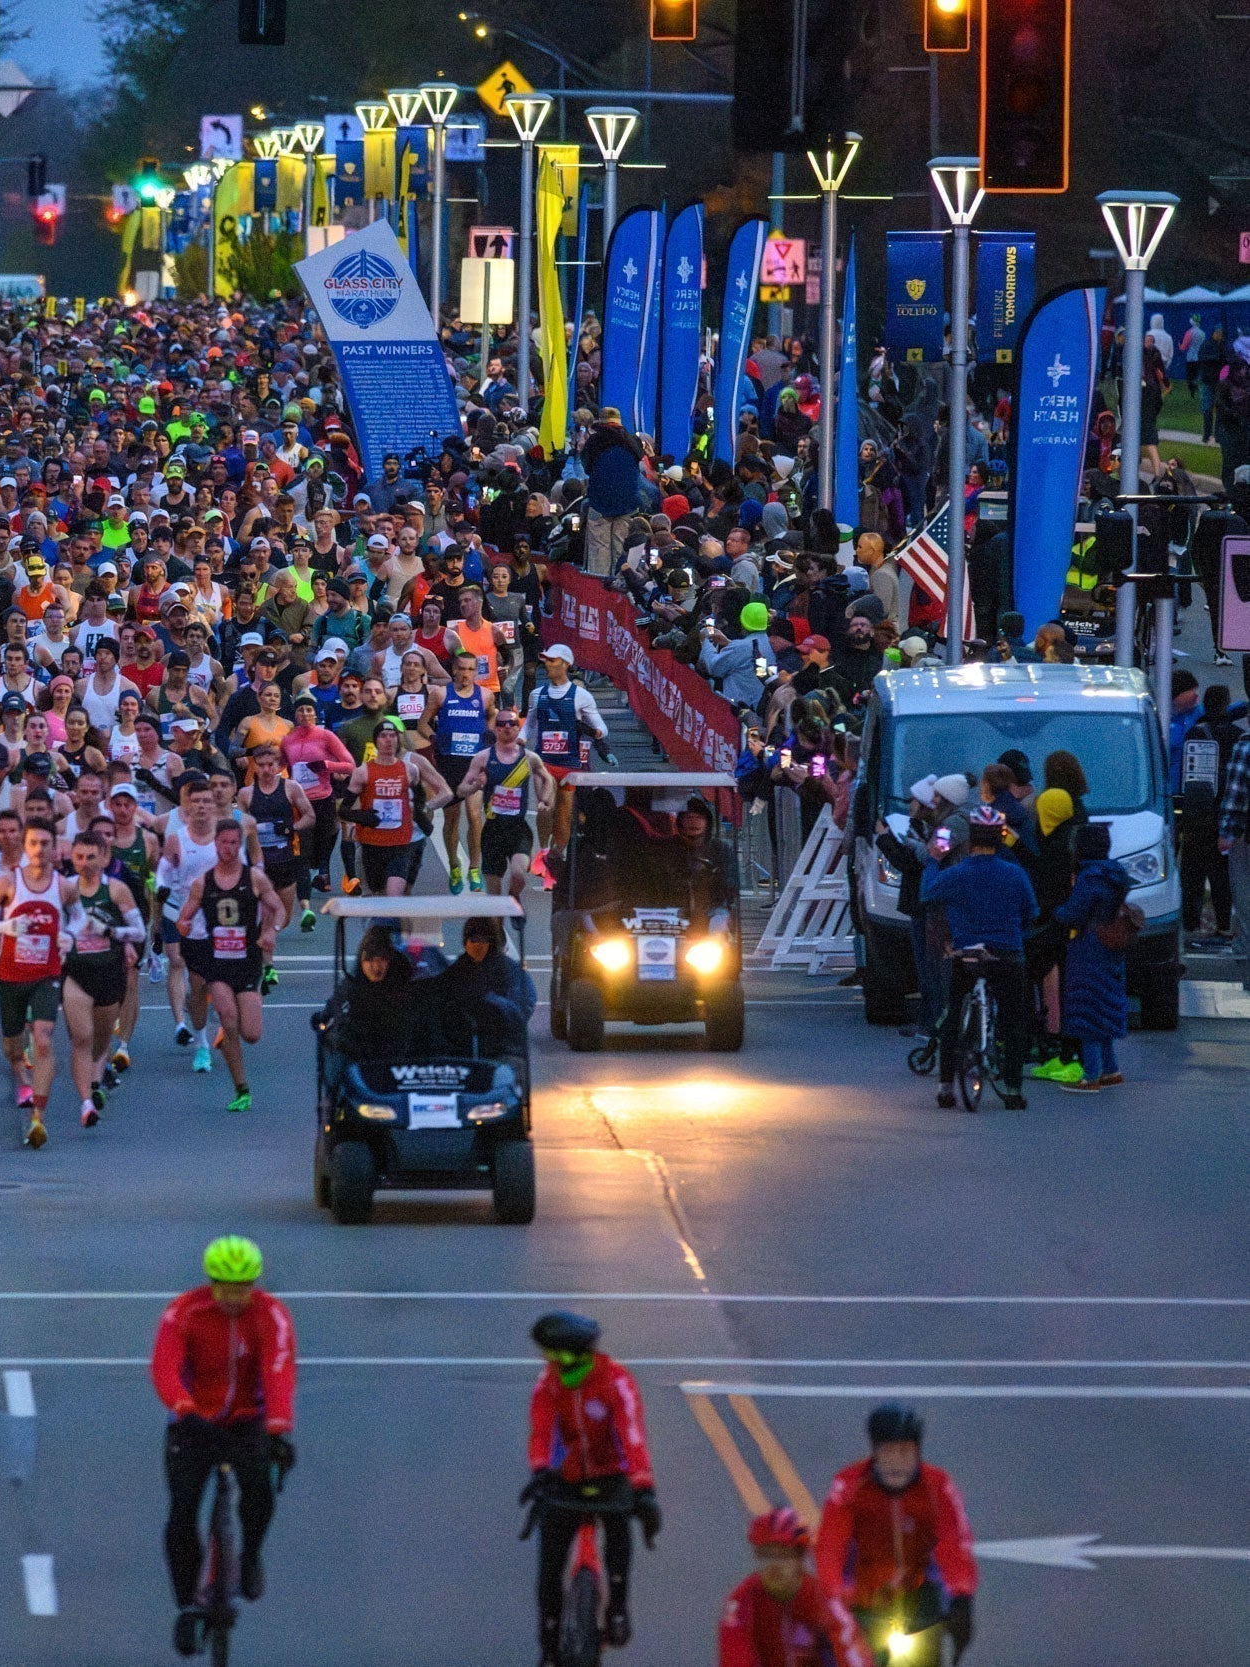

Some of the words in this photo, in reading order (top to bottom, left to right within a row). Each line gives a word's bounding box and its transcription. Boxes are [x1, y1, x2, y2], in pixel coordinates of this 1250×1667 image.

[323, 278, 368, 290] GLASS
[372, 278, 403, 290] CITY
[1005, 246, 1017, 326] TOMORROWS
[336, 290, 392, 298] MARATHON
[896, 307, 937, 316] TOLEDO
[993, 289, 1004, 338] FUELING
[342, 345, 372, 355] PAST
[376, 345, 433, 355] WINNERS
[1064, 620, 1101, 631] elch's
[454, 744, 475, 753] 932
